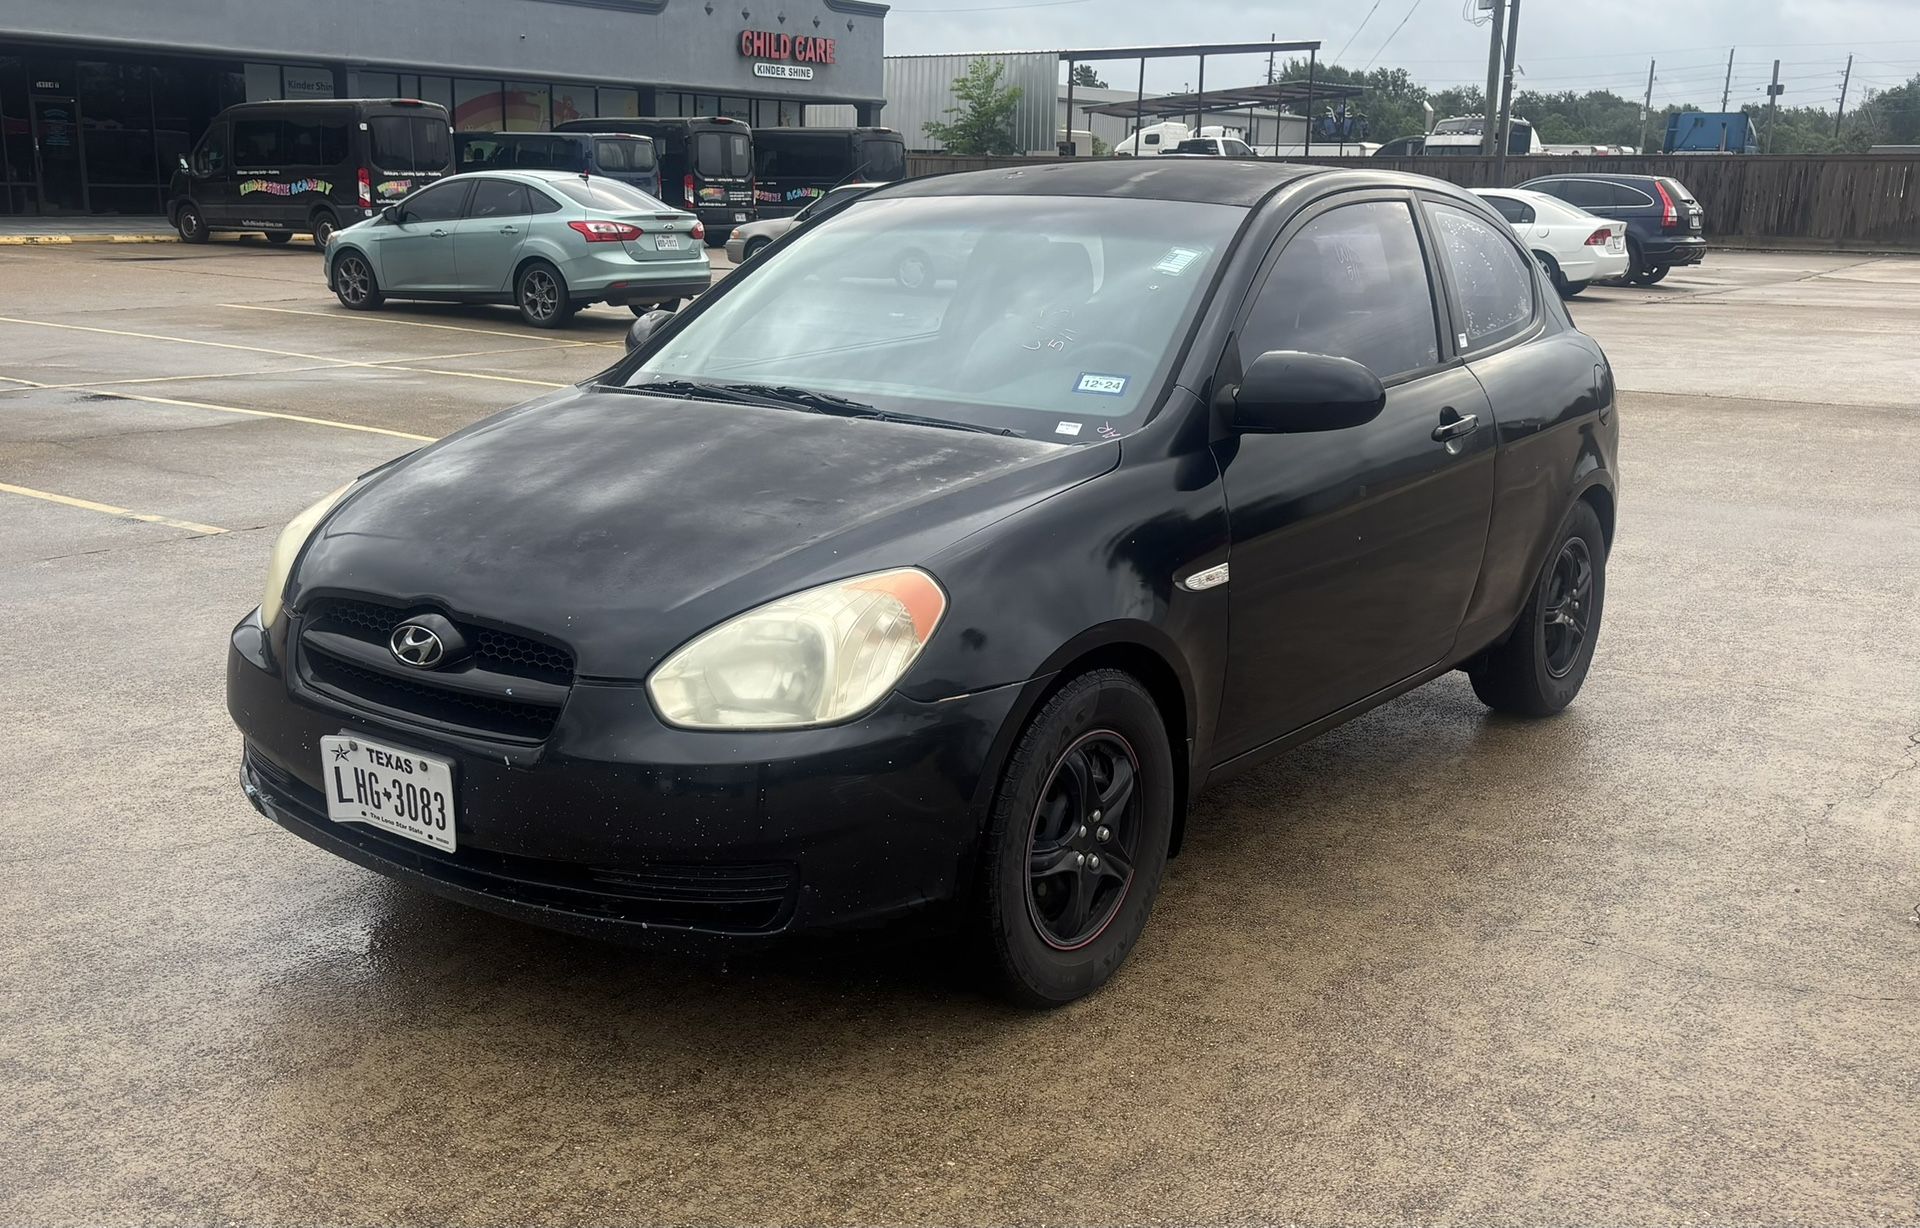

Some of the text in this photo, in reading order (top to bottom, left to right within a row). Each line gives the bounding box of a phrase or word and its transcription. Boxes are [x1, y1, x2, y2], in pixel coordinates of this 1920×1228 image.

[741, 30, 836, 64] CHILD CARE
[757, 64, 811, 78] KINDER SHINE
[288, 80, 315, 90] Kinder
[291, 178, 333, 195] ACADEMY
[786, 187, 826, 201] ACADEMY
[366, 748, 413, 774] TEXAS
[395, 821, 408, 831] Star
[408, 825, 424, 836] State
